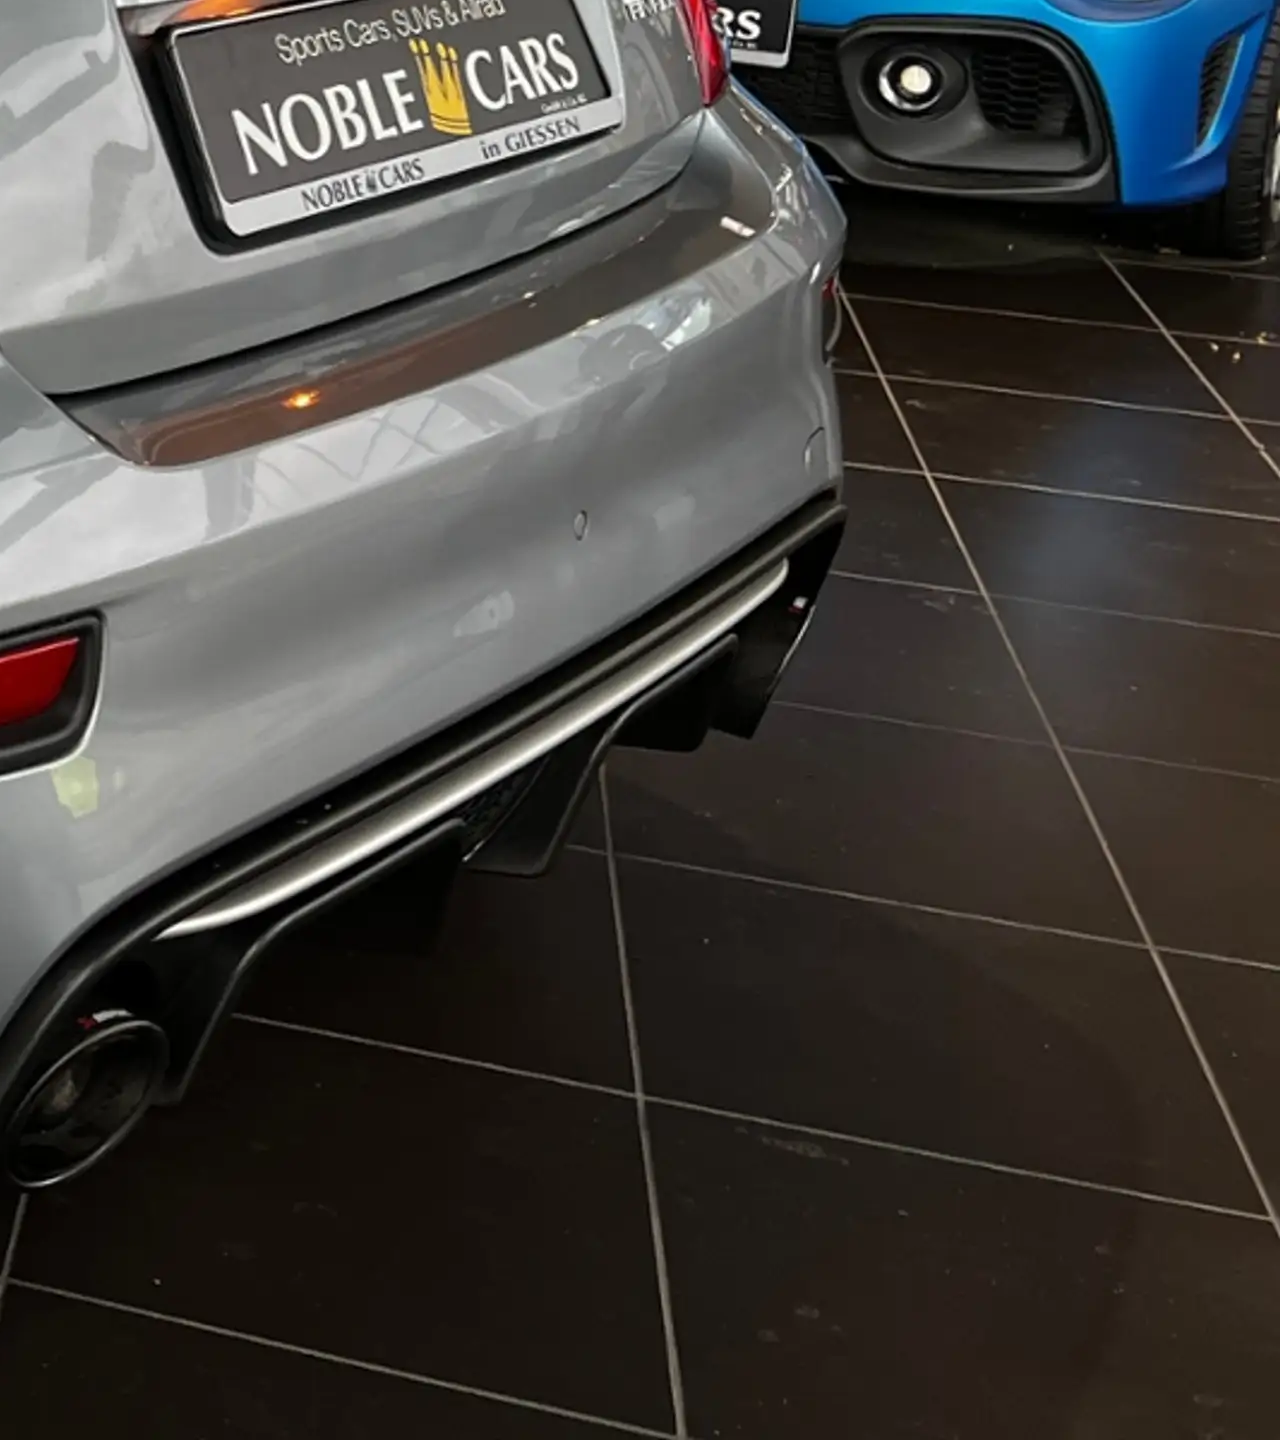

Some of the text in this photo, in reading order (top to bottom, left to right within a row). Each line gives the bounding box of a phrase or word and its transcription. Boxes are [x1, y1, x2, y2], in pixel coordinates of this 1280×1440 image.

[274, 27, 345, 66] Sports
[343, 18, 399, 48] Cars,
[391, 4, 444, 37] SUVs
[441, 0, 459, 26] &
[230, 32, 580, 176] NOBLE CARS
[301, 116, 581, 211] NOBLE CARS in GIESSEN
